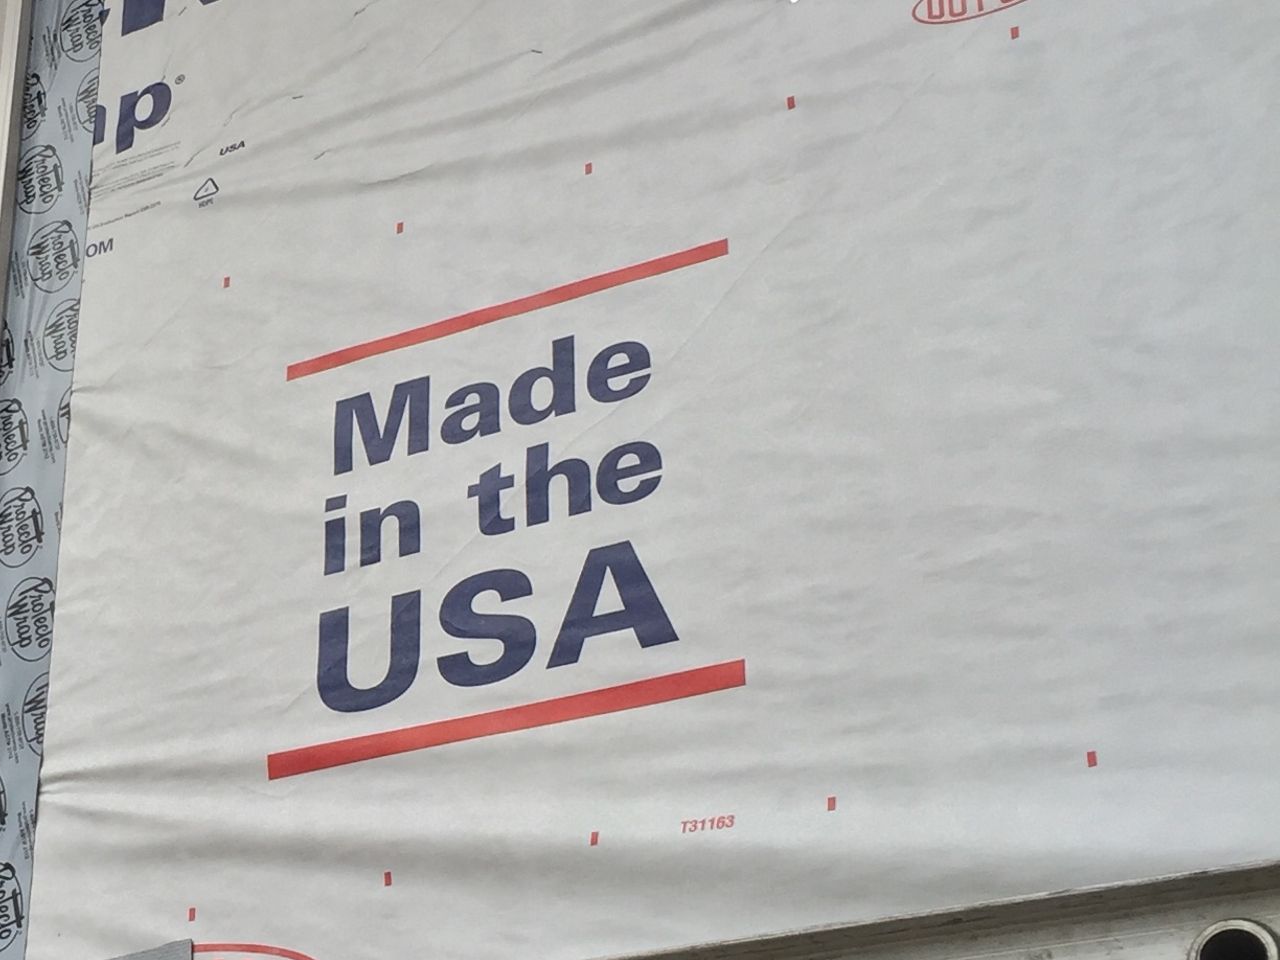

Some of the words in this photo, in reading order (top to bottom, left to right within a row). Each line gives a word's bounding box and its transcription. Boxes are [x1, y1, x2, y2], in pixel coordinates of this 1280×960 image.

[219, 140, 246, 156] USA
[29, 238, 52, 282] Wrap
[45, 317, 67, 361] Wrap
[333, 334, 652, 476] Made
[324, 494, 421, 576] in
[467, 440, 663, 537] the
[7, 596, 32, 649] Wrap
[316, 540, 680, 713] USA
[681, 814, 736, 834] T31163
